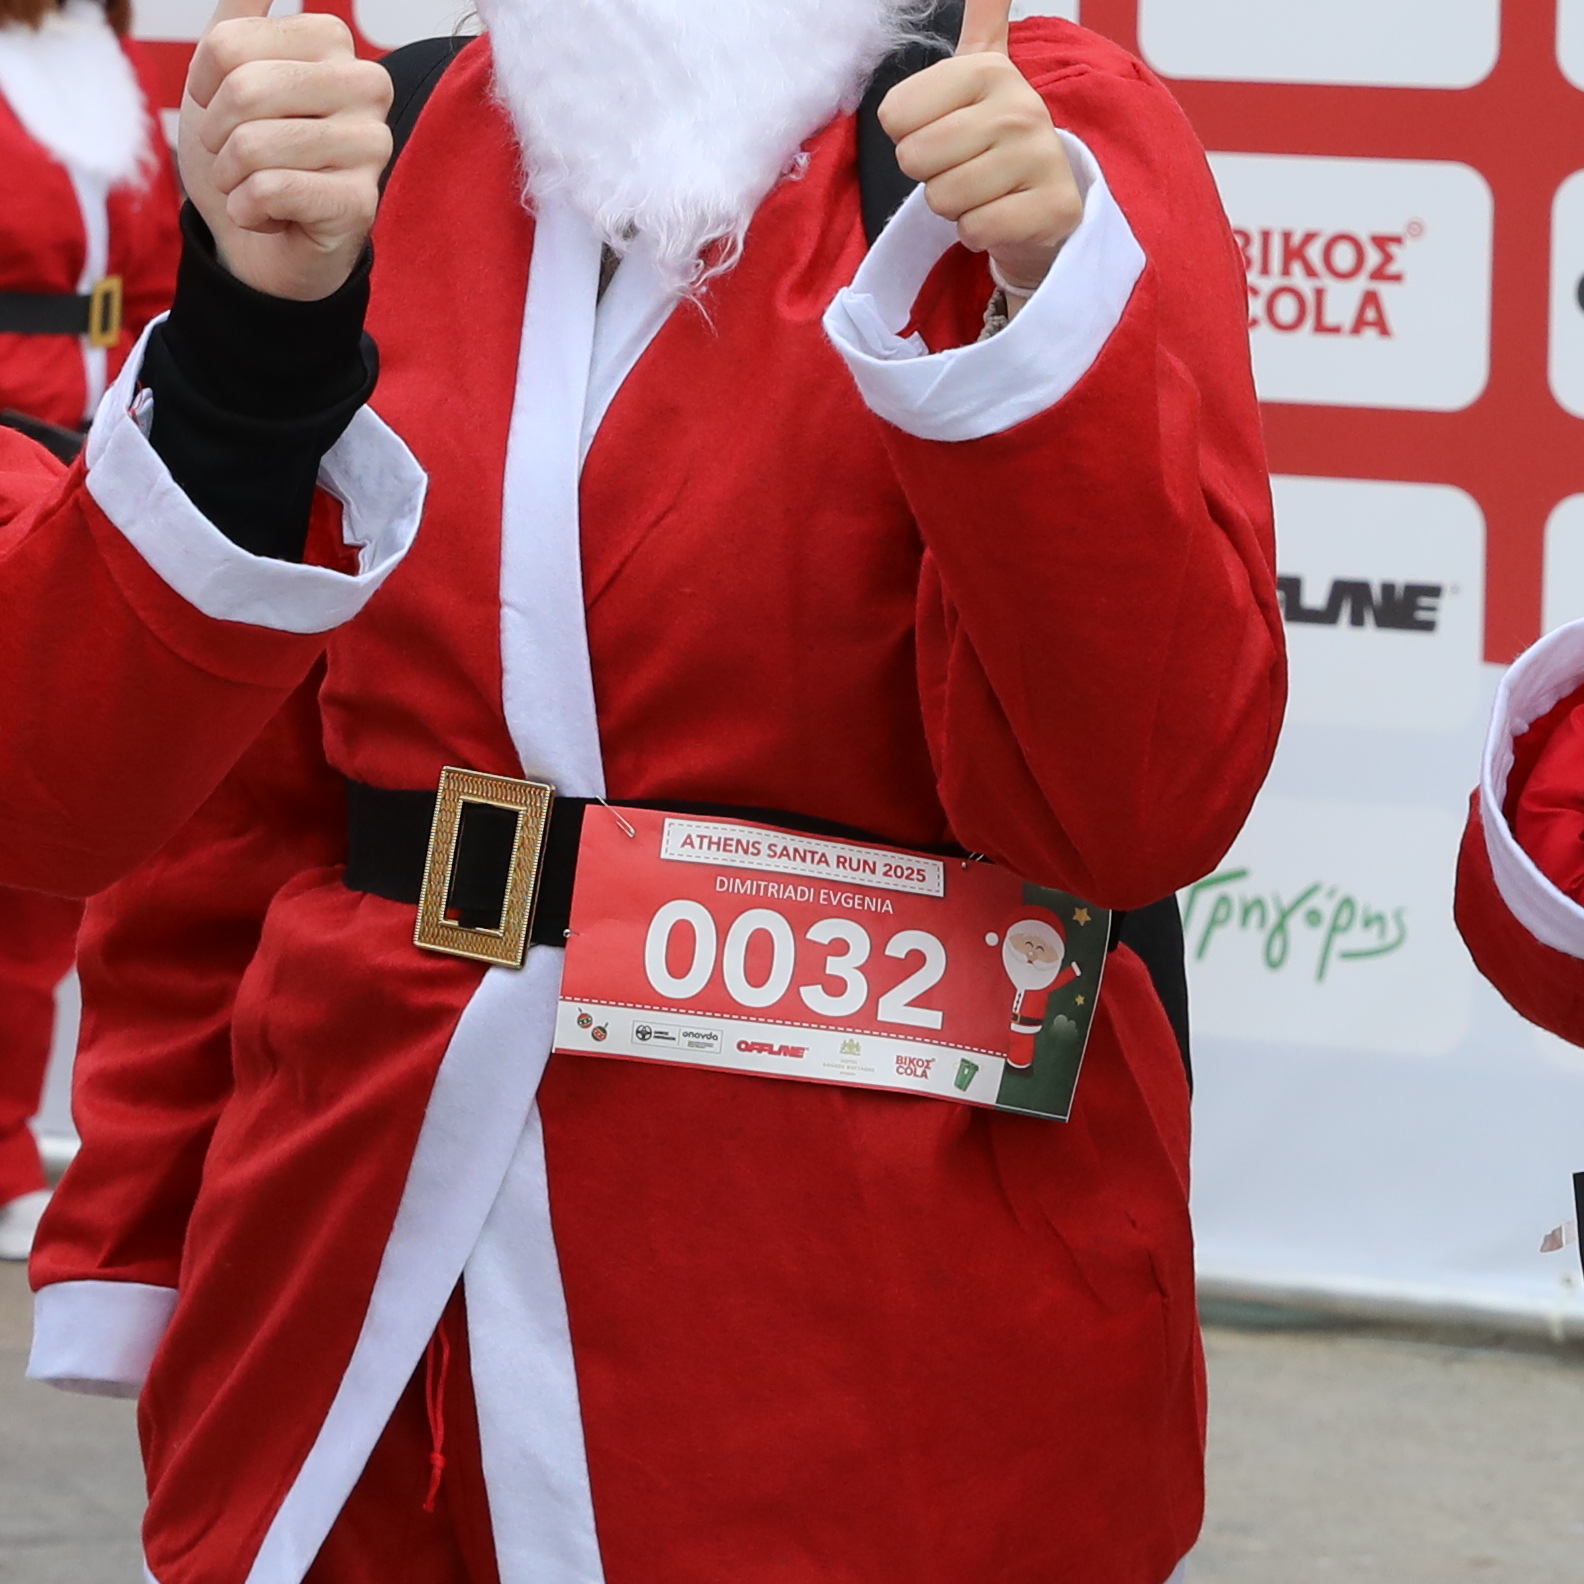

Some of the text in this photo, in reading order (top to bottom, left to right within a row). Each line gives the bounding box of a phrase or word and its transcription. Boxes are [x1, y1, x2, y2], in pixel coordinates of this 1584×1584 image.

[1248, 284, 1392, 336] OLA
[680, 833, 927, 884] ATHENS SANTA RUN 2025
[716, 876, 894, 914] DIMITRIADI EVGENIA
[644, 899, 947, 1030] 0032
[895, 1055, 932, 1069] ΒΙΚΟΣ
[895, 1066, 929, 1079] COLA
